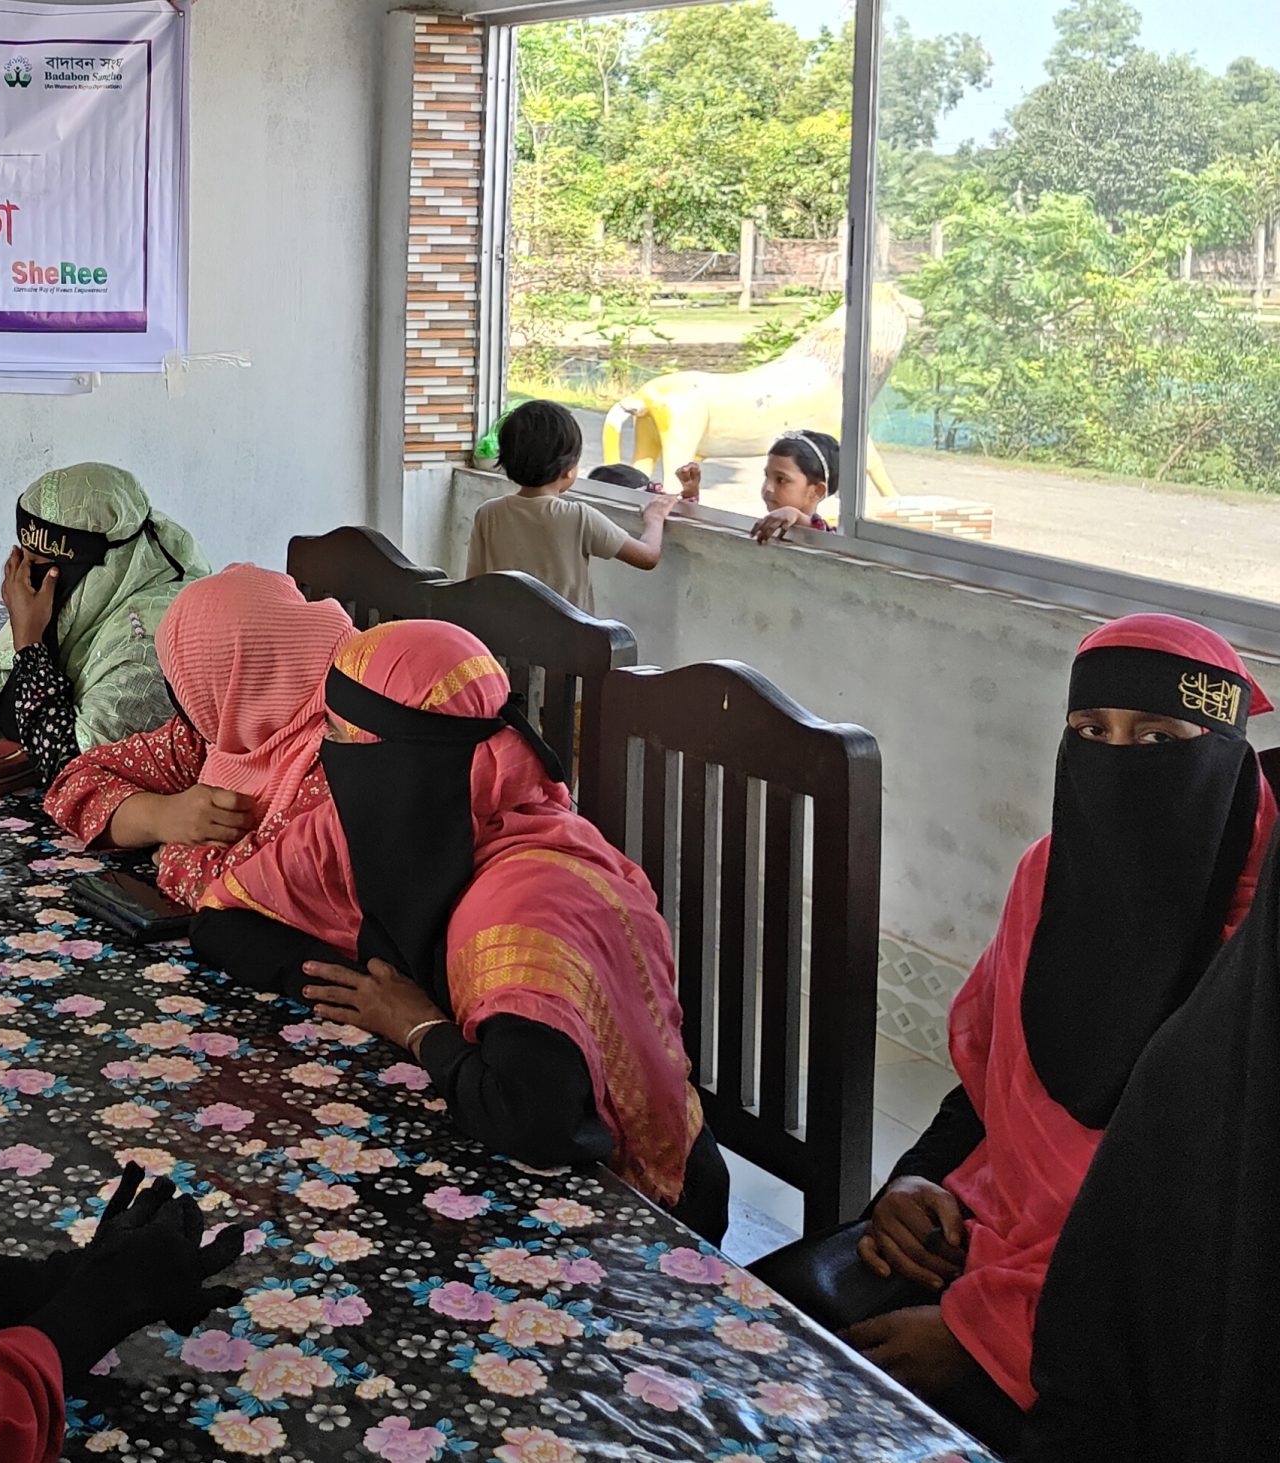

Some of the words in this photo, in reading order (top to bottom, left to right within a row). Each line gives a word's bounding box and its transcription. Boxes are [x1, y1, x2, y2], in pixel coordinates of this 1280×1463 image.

[44, 56, 96, 70] বাদাবন
[44, 71, 90, 81] Badabon
[11, 259, 108, 285] SheRee
